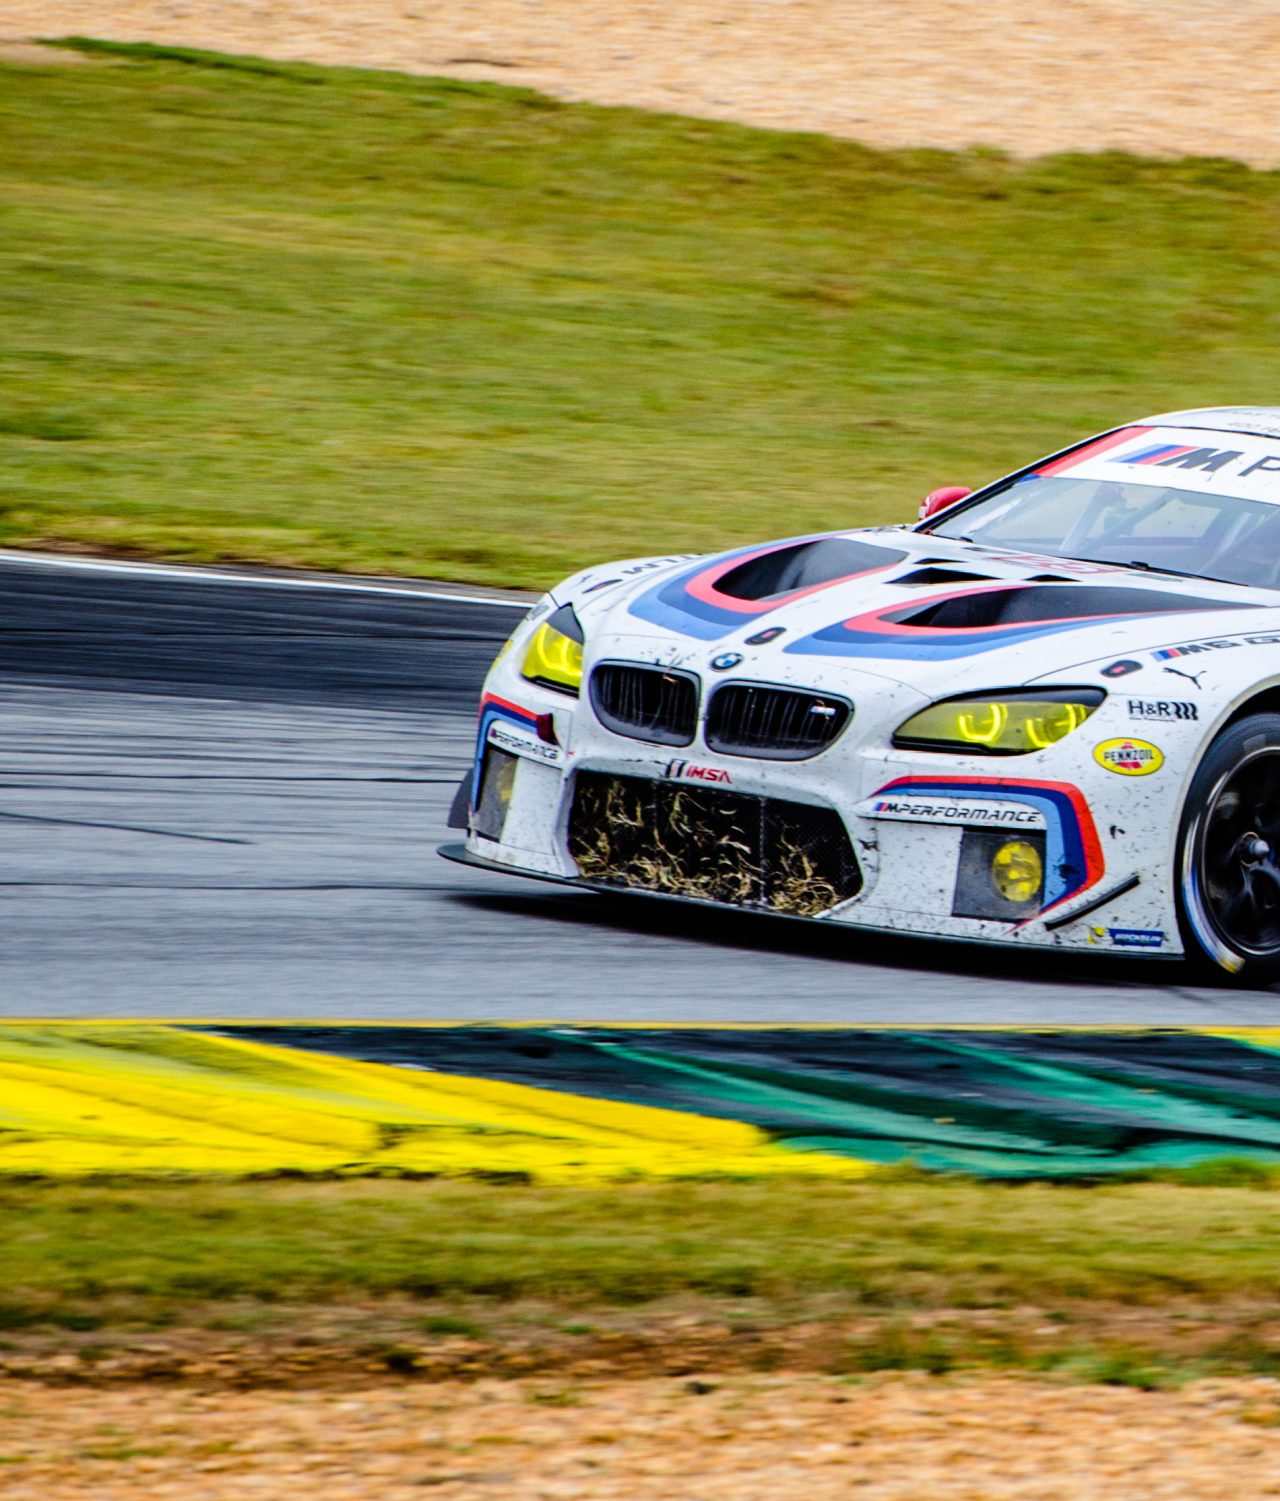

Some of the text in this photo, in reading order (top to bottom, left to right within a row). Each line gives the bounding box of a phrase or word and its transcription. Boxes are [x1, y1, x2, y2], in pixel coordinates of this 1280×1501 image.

[1175, 639, 1243, 656] M6
[1127, 700, 1171, 716] H&R
[1103, 749, 1154, 762] PENNZOIL
